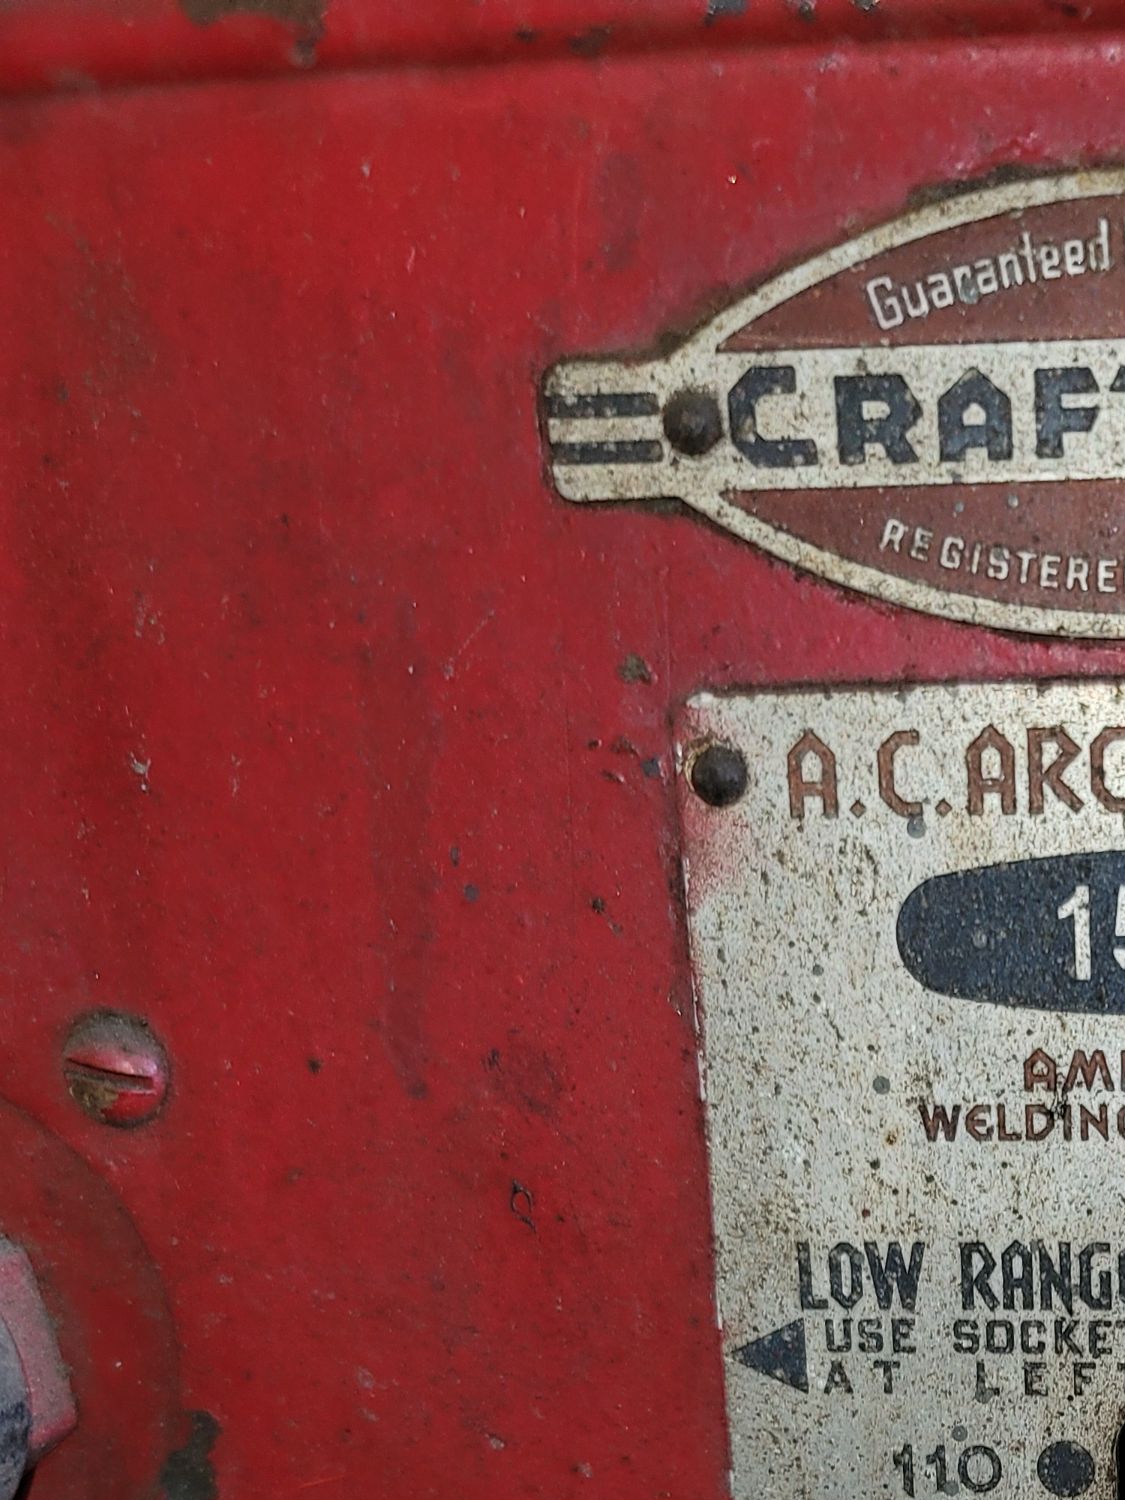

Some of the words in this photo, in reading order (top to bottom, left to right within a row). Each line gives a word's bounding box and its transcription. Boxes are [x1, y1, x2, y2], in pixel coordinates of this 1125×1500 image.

[865, 219, 1110, 329] Guaranteed
[797, 1241, 926, 1311] LOW
[824, 1318, 917, 1355] USE
[823, 1361, 901, 1395] AT
[893, 1443, 1002, 1498] 110
